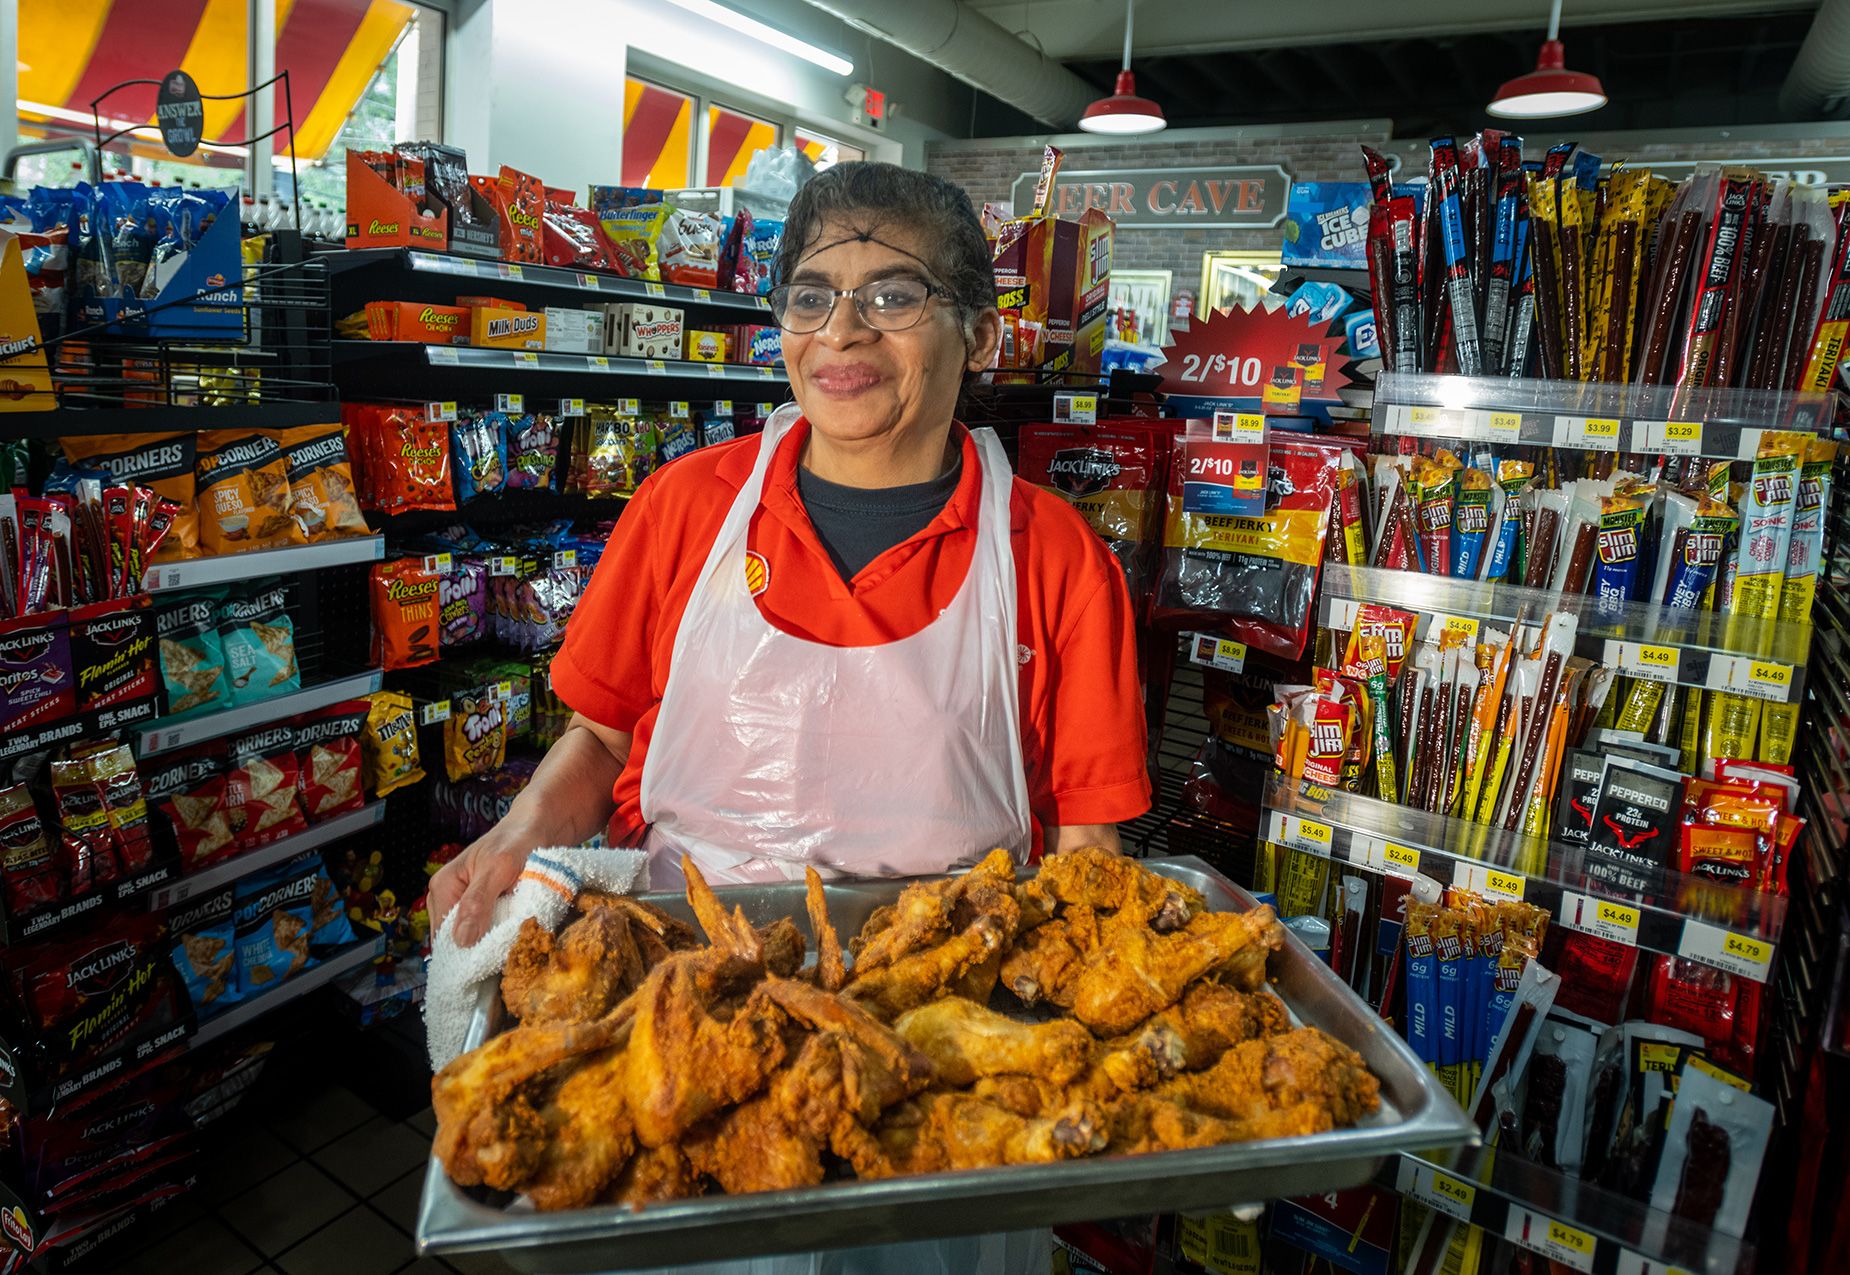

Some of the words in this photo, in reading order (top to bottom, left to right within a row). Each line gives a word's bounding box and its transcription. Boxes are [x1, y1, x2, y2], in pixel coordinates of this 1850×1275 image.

[157, 101, 202, 119] ANSWER
[1052, 181, 1138, 216] EER
[1147, 178, 1266, 216] CAVE
[600, 208, 659, 222] Butterfinger
[368, 219, 400, 235] Reese's
[1321, 215, 1351, 235] ICE
[1320, 224, 1368, 251] CUBE
[1716, 226, 1739, 256] 100%
[1710, 257, 1731, 283] BEEF
[196, 288, 238, 303] Ranch
[997, 288, 1025, 309] BOSS
[418, 306, 459, 325] Reese's
[488, 319, 511, 338] Milk
[513, 315, 538, 333] Duds
[635, 320, 681, 340] WHOPPERS
[1050, 331, 1074, 343] CHEESE
[1180, 353, 1262, 386] 2/$10
[1815, 337, 1841, 389] TERIYAKI
[1075, 401, 1093, 410] $8.99
[595, 421, 630, 435] HARIBO
[1240, 418, 1260, 428] $8.99
[1494, 417, 1516, 426] $3.49
[1587, 424, 1611, 433] $3.99
[1667, 427, 1693, 436] $3.29
[401, 443, 442, 458] Reese's
[1046, 459, 1078, 474] JACK
[1190, 457, 1233, 476] 2/$10
[1755, 477, 1791, 493] slim
[213, 487, 240, 503] SPICY
[214, 499, 244, 514] QUESO
[1421, 504, 1449, 519] slim
[1457, 504, 1486, 520] slim
[1204, 516, 1233, 527] BEEF
[1233, 518, 1274, 533] JERKY
[1603, 512, 1637, 526] MONSTER
[1752, 516, 1787, 528] SONIC
[1791, 520, 1815, 531] ONIC
[1212, 531, 1260, 545] TERIYAKI
[1599, 531, 1635, 548] slim
[1686, 534, 1721, 550] slim
[1494, 538, 1506, 565] MILD
[1606, 543, 1637, 562] jim
[1690, 548, 1721, 565] jim
[1458, 551, 1470, 576] MILD
[389, 579, 438, 602] Reese's
[1608, 588, 1620, 612] BBQ
[84, 621, 112, 637] JACK
[112, 613, 142, 630] LINK'S
[1449, 620, 1473, 632] $4.49
[21, 630, 55, 647] LINK'S
[230, 644, 256, 659] SEA
[1221, 644, 1241, 656] $8.99
[1642, 649, 1670, 662] $4.49
[79, 650, 127, 688] Flamin'
[127, 635, 154, 657] Hot
[231, 655, 256, 669] SALT
[1364, 658, 1383, 670] slim
[103, 670, 135, 692] ORIGINAL
[1755, 667, 1785, 682] $4.49
[94, 693, 116, 710] MEAT
[117, 676, 146, 697] STICKS
[1370, 679, 1385, 691] 6g
[3, 715, 28, 733] MEAT
[29, 696, 61, 718] STICKS
[98, 711, 114, 722] ONE
[99, 718, 118, 730] EPIC
[117, 702, 152, 721] SNACK
[0, 740, 40, 757] LEGENDARY
[39, 722, 84, 744] BRANDS
[7, 735, 30, 746] TWO
[292, 718, 360, 746] CORNERS
[227, 726, 293, 758] CORNERS
[1304, 767, 1341, 783] CHEESE
[1608, 784, 1670, 810] PEPPERED
[1615, 813, 1650, 829] PROTEIN
[1626, 806, 1643, 819] 23g
[1301, 824, 1325, 838] $5.49
[1561, 827, 1589, 841] JACK
[1388, 849, 1413, 864] $2.49
[1588, 841, 1620, 858] JACK
[1692, 845, 1724, 856] SWEET
[1724, 848, 1733, 856] &
[1735, 849, 1753, 858] HOT
[135, 867, 169, 890] SNACK
[1490, 876, 1518, 892] $2.49
[1588, 864, 1617, 882] 100%
[1618, 876, 1647, 892] BEEF
[232, 873, 318, 926] POPCORNERS
[23, 914, 61, 936] LEGENDARY
[60, 894, 104, 920] BRANDS
[31, 912, 52, 925] TWO
[1601, 907, 1633, 924] $4.49
[1408, 934, 1430, 947] slim
[1438, 935, 1460, 949] slim
[1727, 939, 1760, 957] $4.79
[1413, 943, 1433, 957] jim
[1442, 945, 1461, 961] jim
[66, 963, 101, 989] JACK
[99, 944, 137, 971] LINK'S
[1411, 961, 1428, 975] 6g
[1441, 964, 1457, 977] 6g
[68, 988, 127, 1051] Flamin'
[126, 961, 157, 996] Hot
[1495, 994, 1512, 1009] 6g
[1414, 1002, 1425, 1038] MILD
[1444, 1005, 1456, 1040] MILD
[153, 1024, 187, 1048] SNACK
[81, 1056, 123, 1086] BRANDS
[79, 1119, 115, 1140] JACK
[1438, 1180, 1468, 1200] $2.49
[96, 1213, 137, 1243] BRANDS
[1550, 1224, 1584, 1248] $4.79
